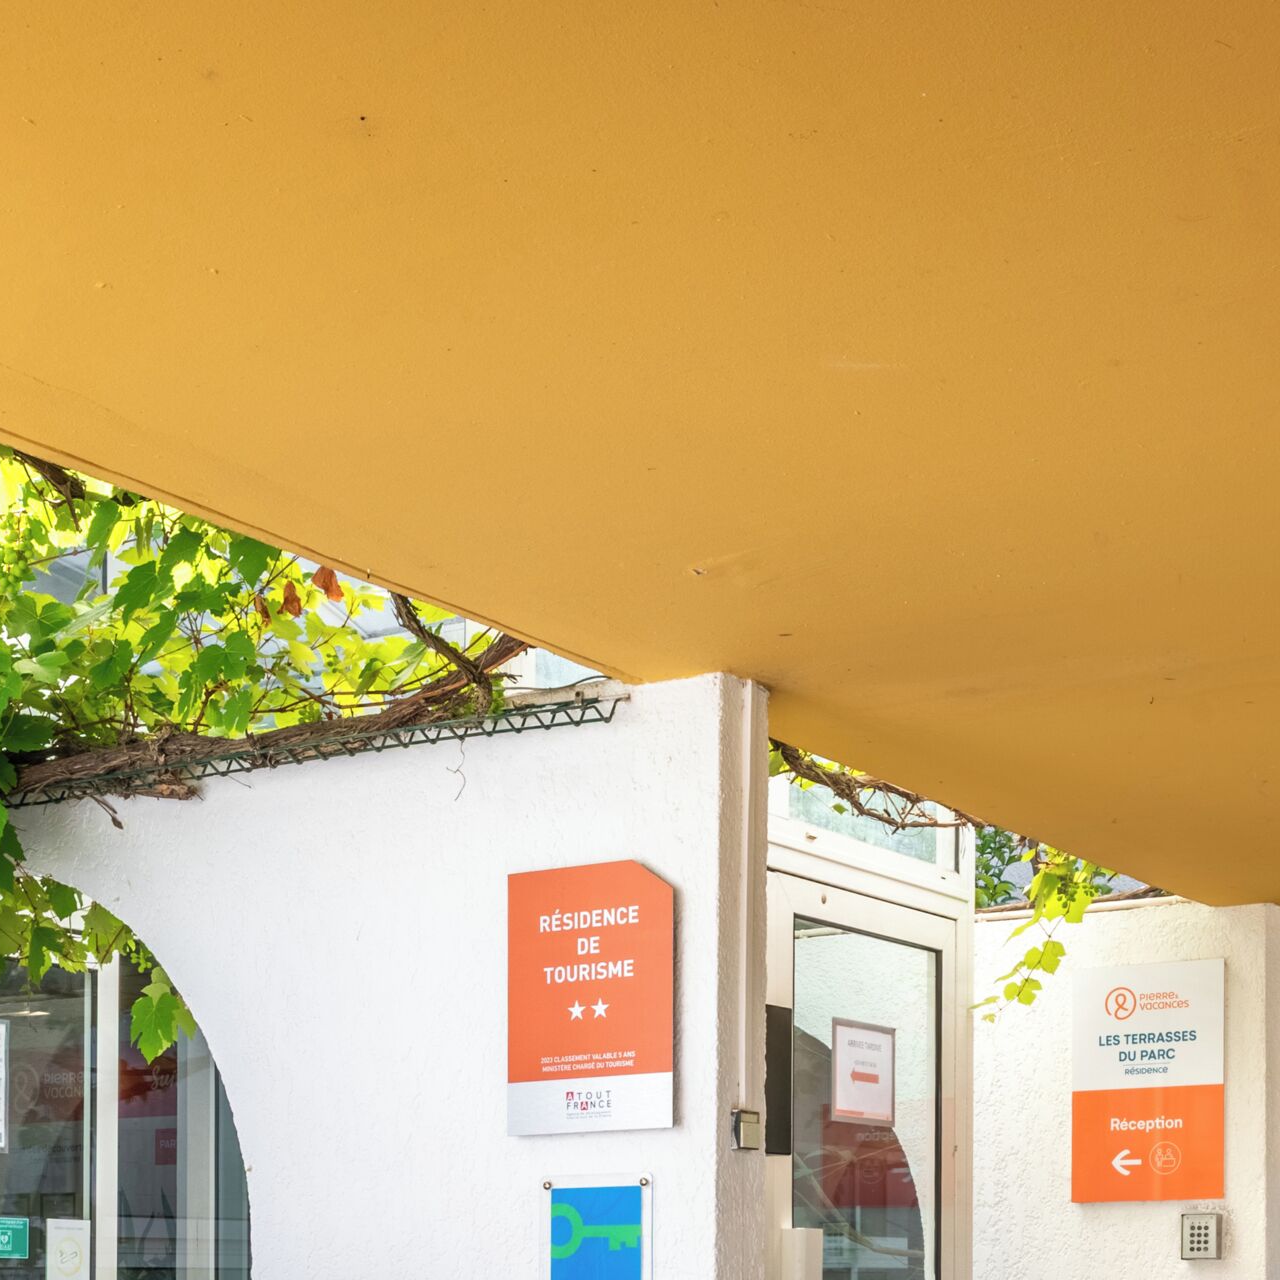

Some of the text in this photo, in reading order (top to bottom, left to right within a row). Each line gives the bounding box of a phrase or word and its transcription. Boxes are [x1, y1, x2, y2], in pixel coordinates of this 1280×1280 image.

[539, 905, 640, 933] RÉSIDENCE
[577, 936, 600, 955] DE
[543, 959, 634, 985] TOURISME
[1098, 1030, 1198, 1047] LES TERRASSES
[553, 1053, 590, 1063] CLASSEMENT
[591, 1052, 617, 1060] VALABLE
[623, 1050, 636, 1058] ANS
[1118, 1048, 1176, 1062] DU PARC
[596, 1061, 605, 1069] DU
[606, 1059, 634, 1068] TOURISME
[565, 1090, 612, 1101] ATOUT
[565, 1098, 612, 1111] FRANCE
[1110, 1115, 1183, 1133] Réception
